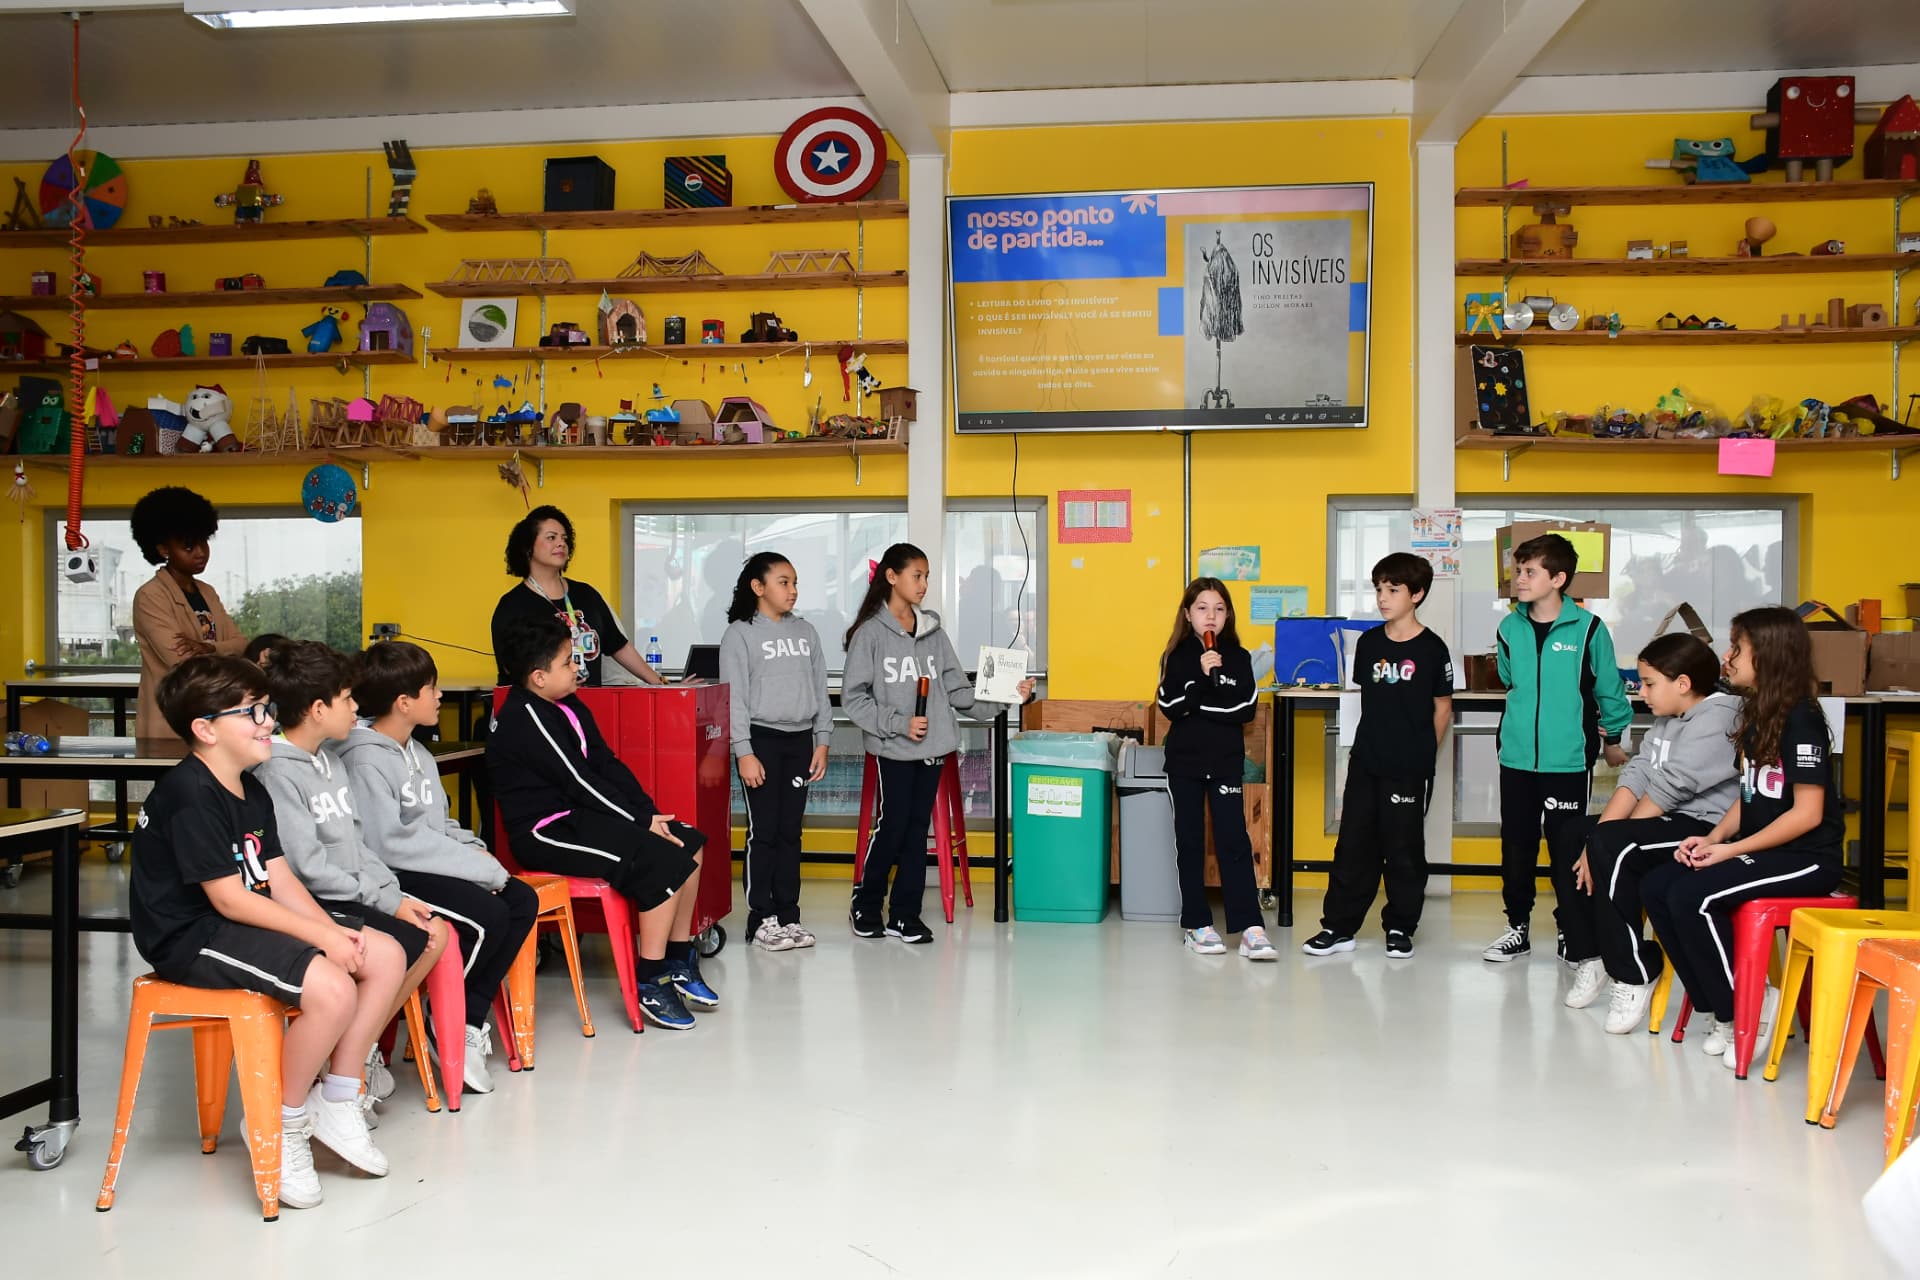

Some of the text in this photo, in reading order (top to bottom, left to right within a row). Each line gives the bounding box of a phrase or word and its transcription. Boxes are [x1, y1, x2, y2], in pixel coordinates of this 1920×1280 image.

[967, 205, 1114, 230] nosso ponto
[967, 225, 1105, 254] de partida...
[1252, 232, 1274, 258] OS
[1252, 255, 1346, 285] INVISÍVEIS
[986, 314, 1004, 322] QUE
[762, 638, 811, 660] SALG
[1372, 662, 1413, 681] SALG
[1558, 801, 1579, 810] SALG
